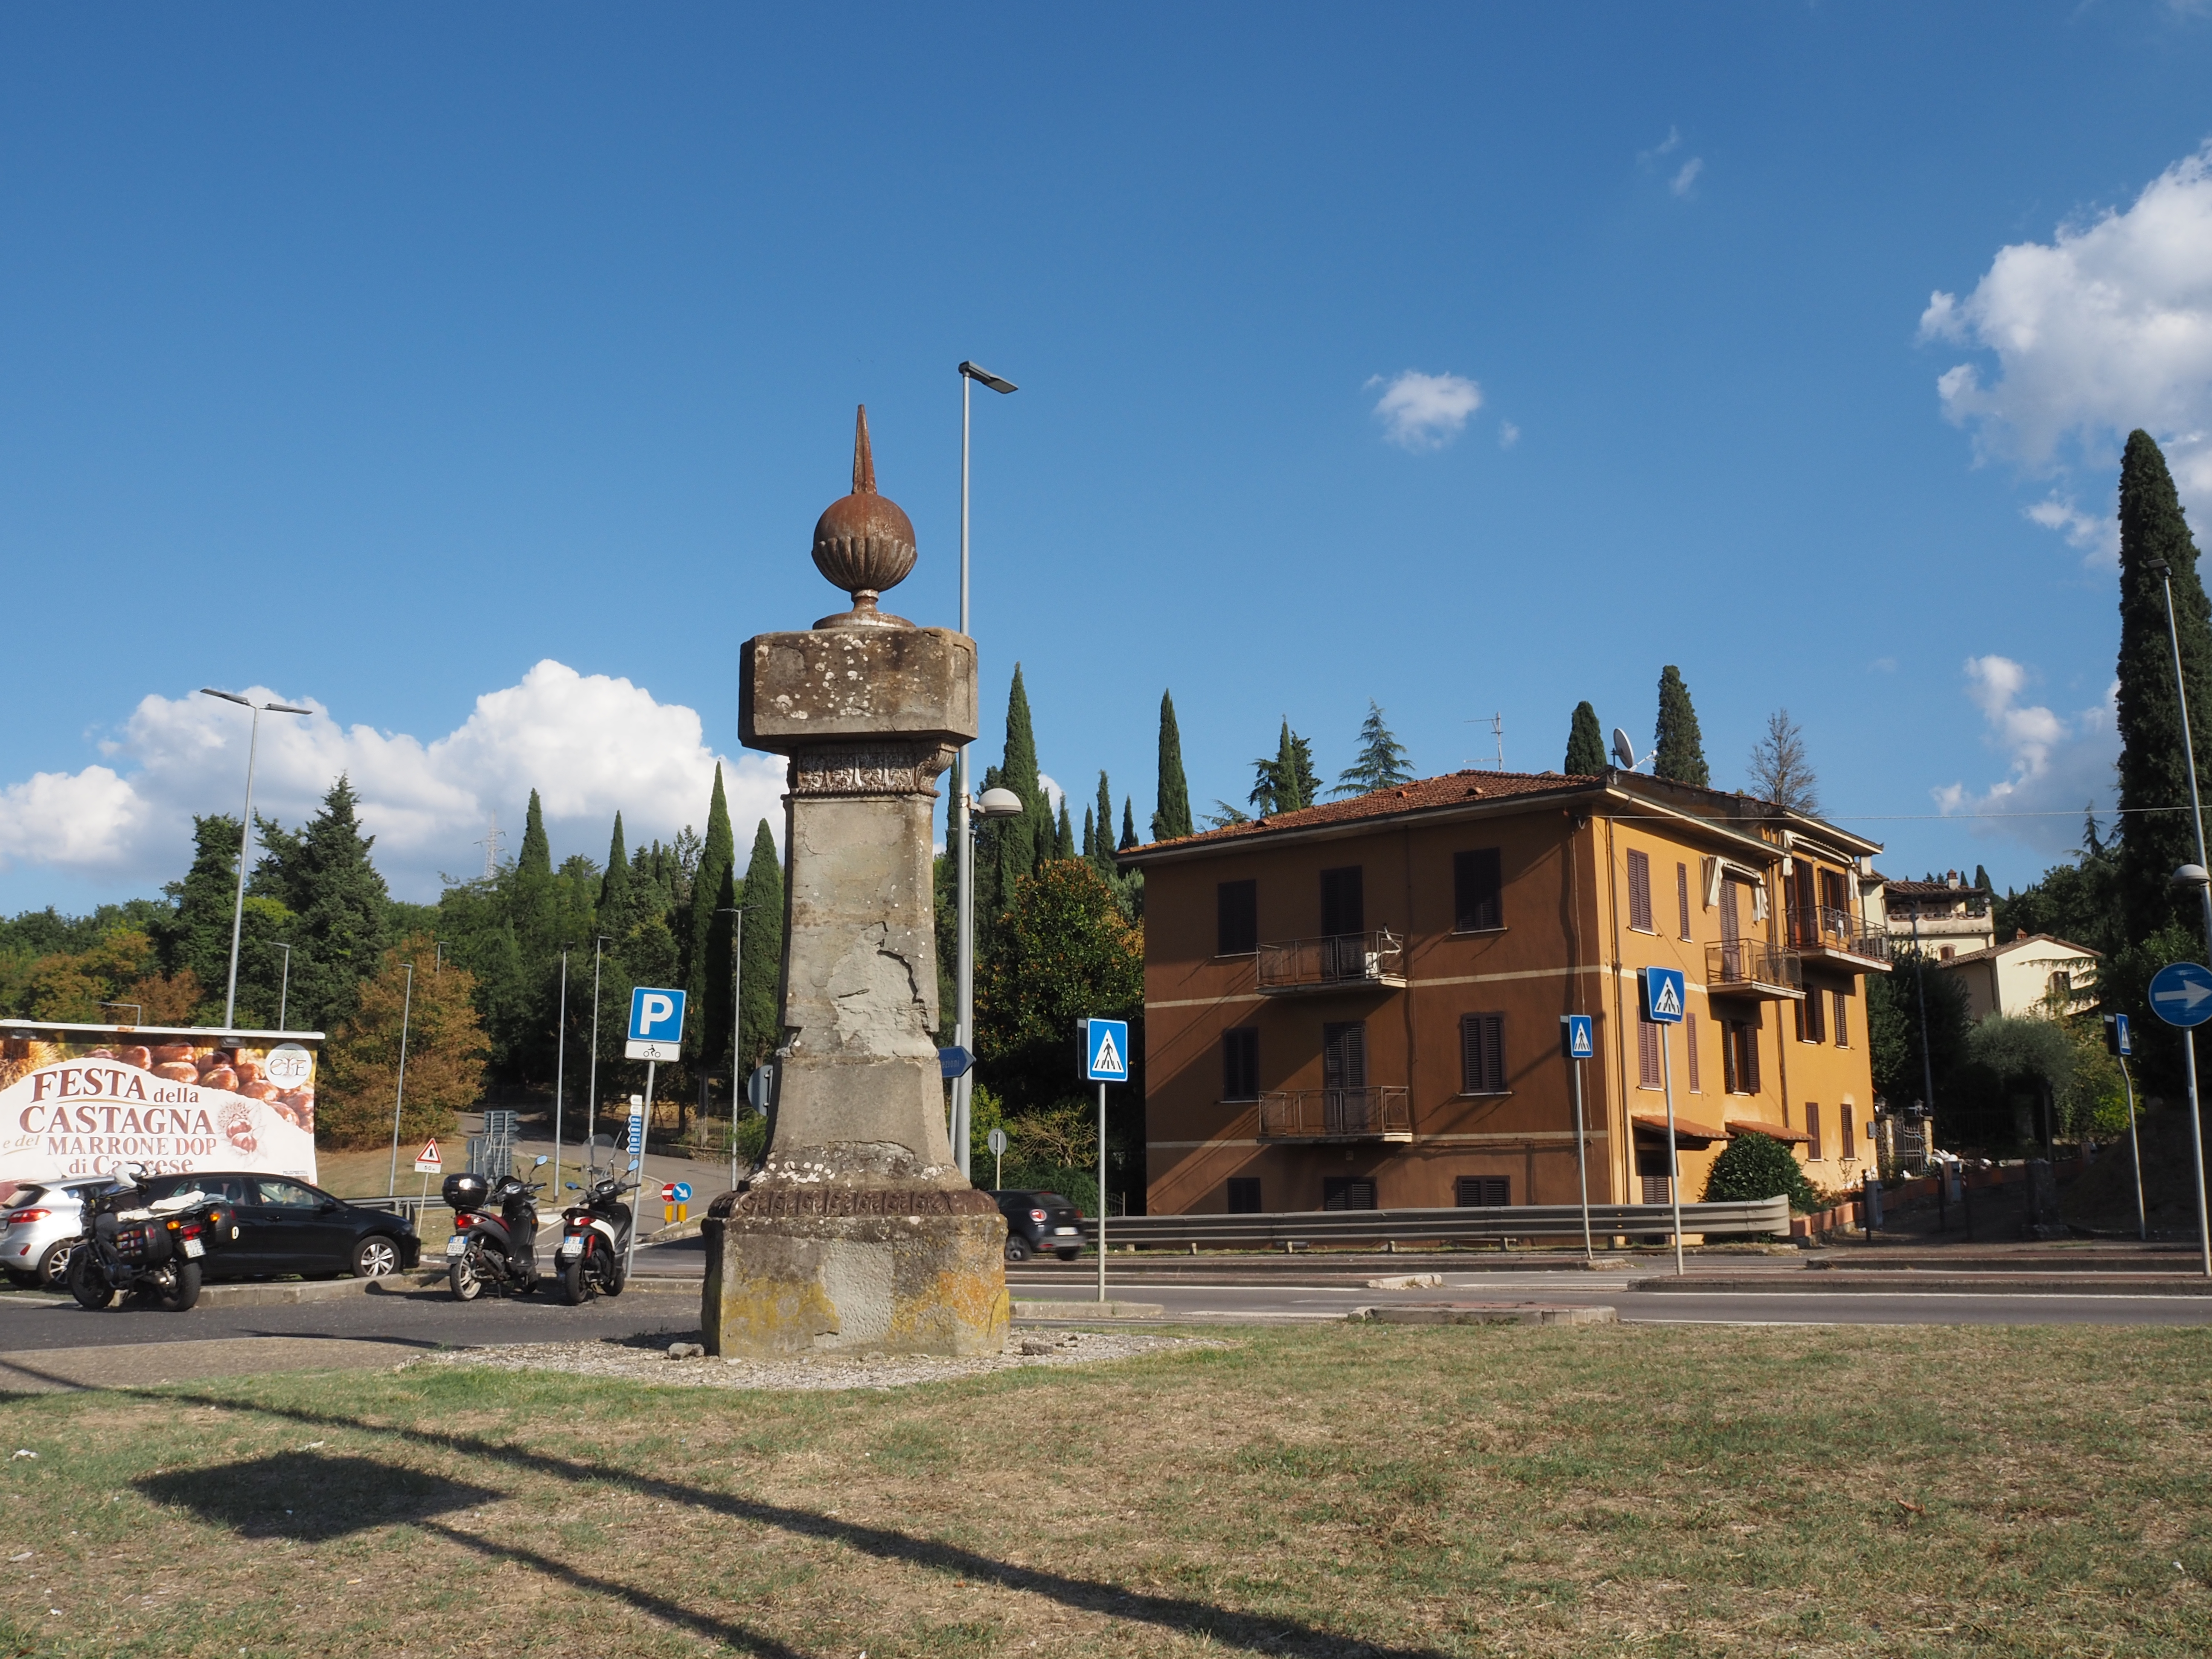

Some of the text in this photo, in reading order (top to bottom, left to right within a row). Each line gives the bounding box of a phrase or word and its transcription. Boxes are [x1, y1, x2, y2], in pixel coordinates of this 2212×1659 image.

[640, 994, 674, 1035] P
[30, 1068, 200, 1103] FESTA della
[19, 1106, 216, 1135] CASTAGNA
[3, 1135, 217, 1155] e del MARRONE DOP
[69, 1158, 87, 1174] di
